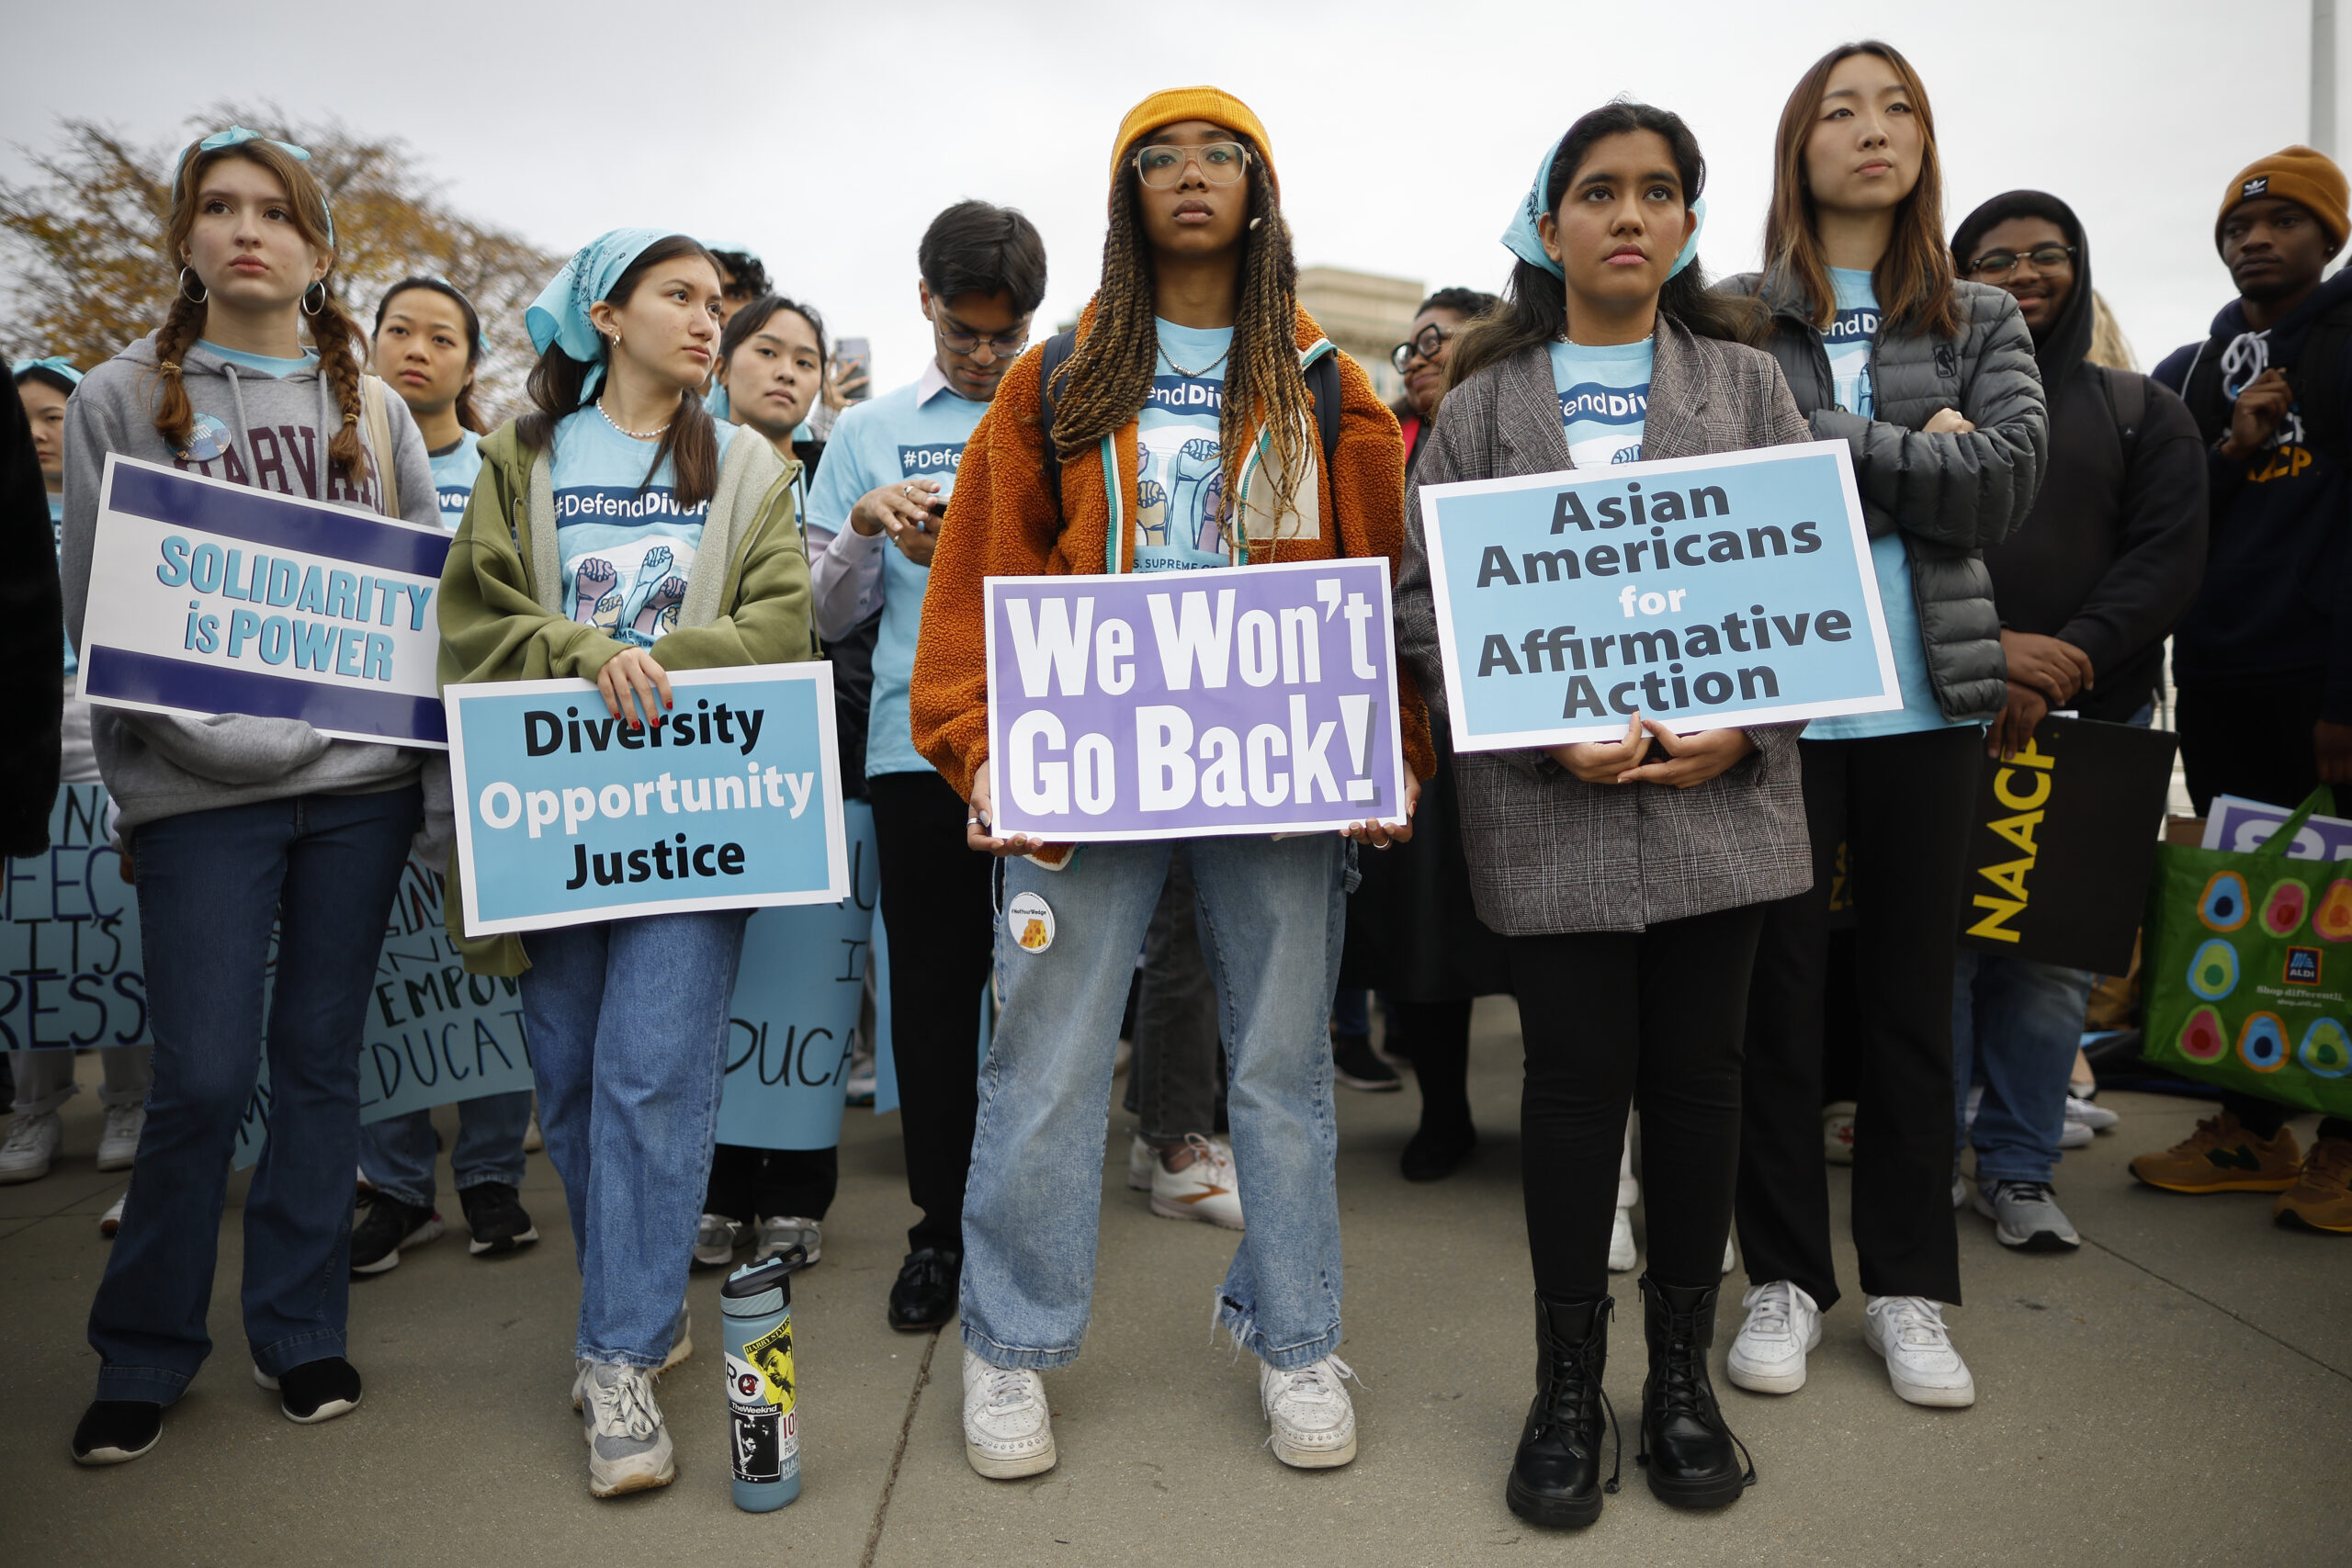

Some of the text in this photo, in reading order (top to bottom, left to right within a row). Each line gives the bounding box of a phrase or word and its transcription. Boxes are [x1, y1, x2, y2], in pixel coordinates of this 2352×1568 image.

[1549, 481, 1730, 536] Asian
[156, 535, 433, 631] SOLIDARITY
[1476, 521, 1823, 589] Americans
[1004, 578, 1377, 698] We Won't
[1619, 584, 1687, 618] for
[184, 600, 395, 682] is POWER
[1477, 604, 1853, 678] Affirmative
[524, 698, 765, 757] Diversity
[1562, 662, 1781, 719] Action
[1008, 693, 1375, 817] Go Back!
[479, 761, 815, 839] Opportunity
[565, 832, 746, 890] Justice
[359, 1009, 534, 1108] DUCAT
